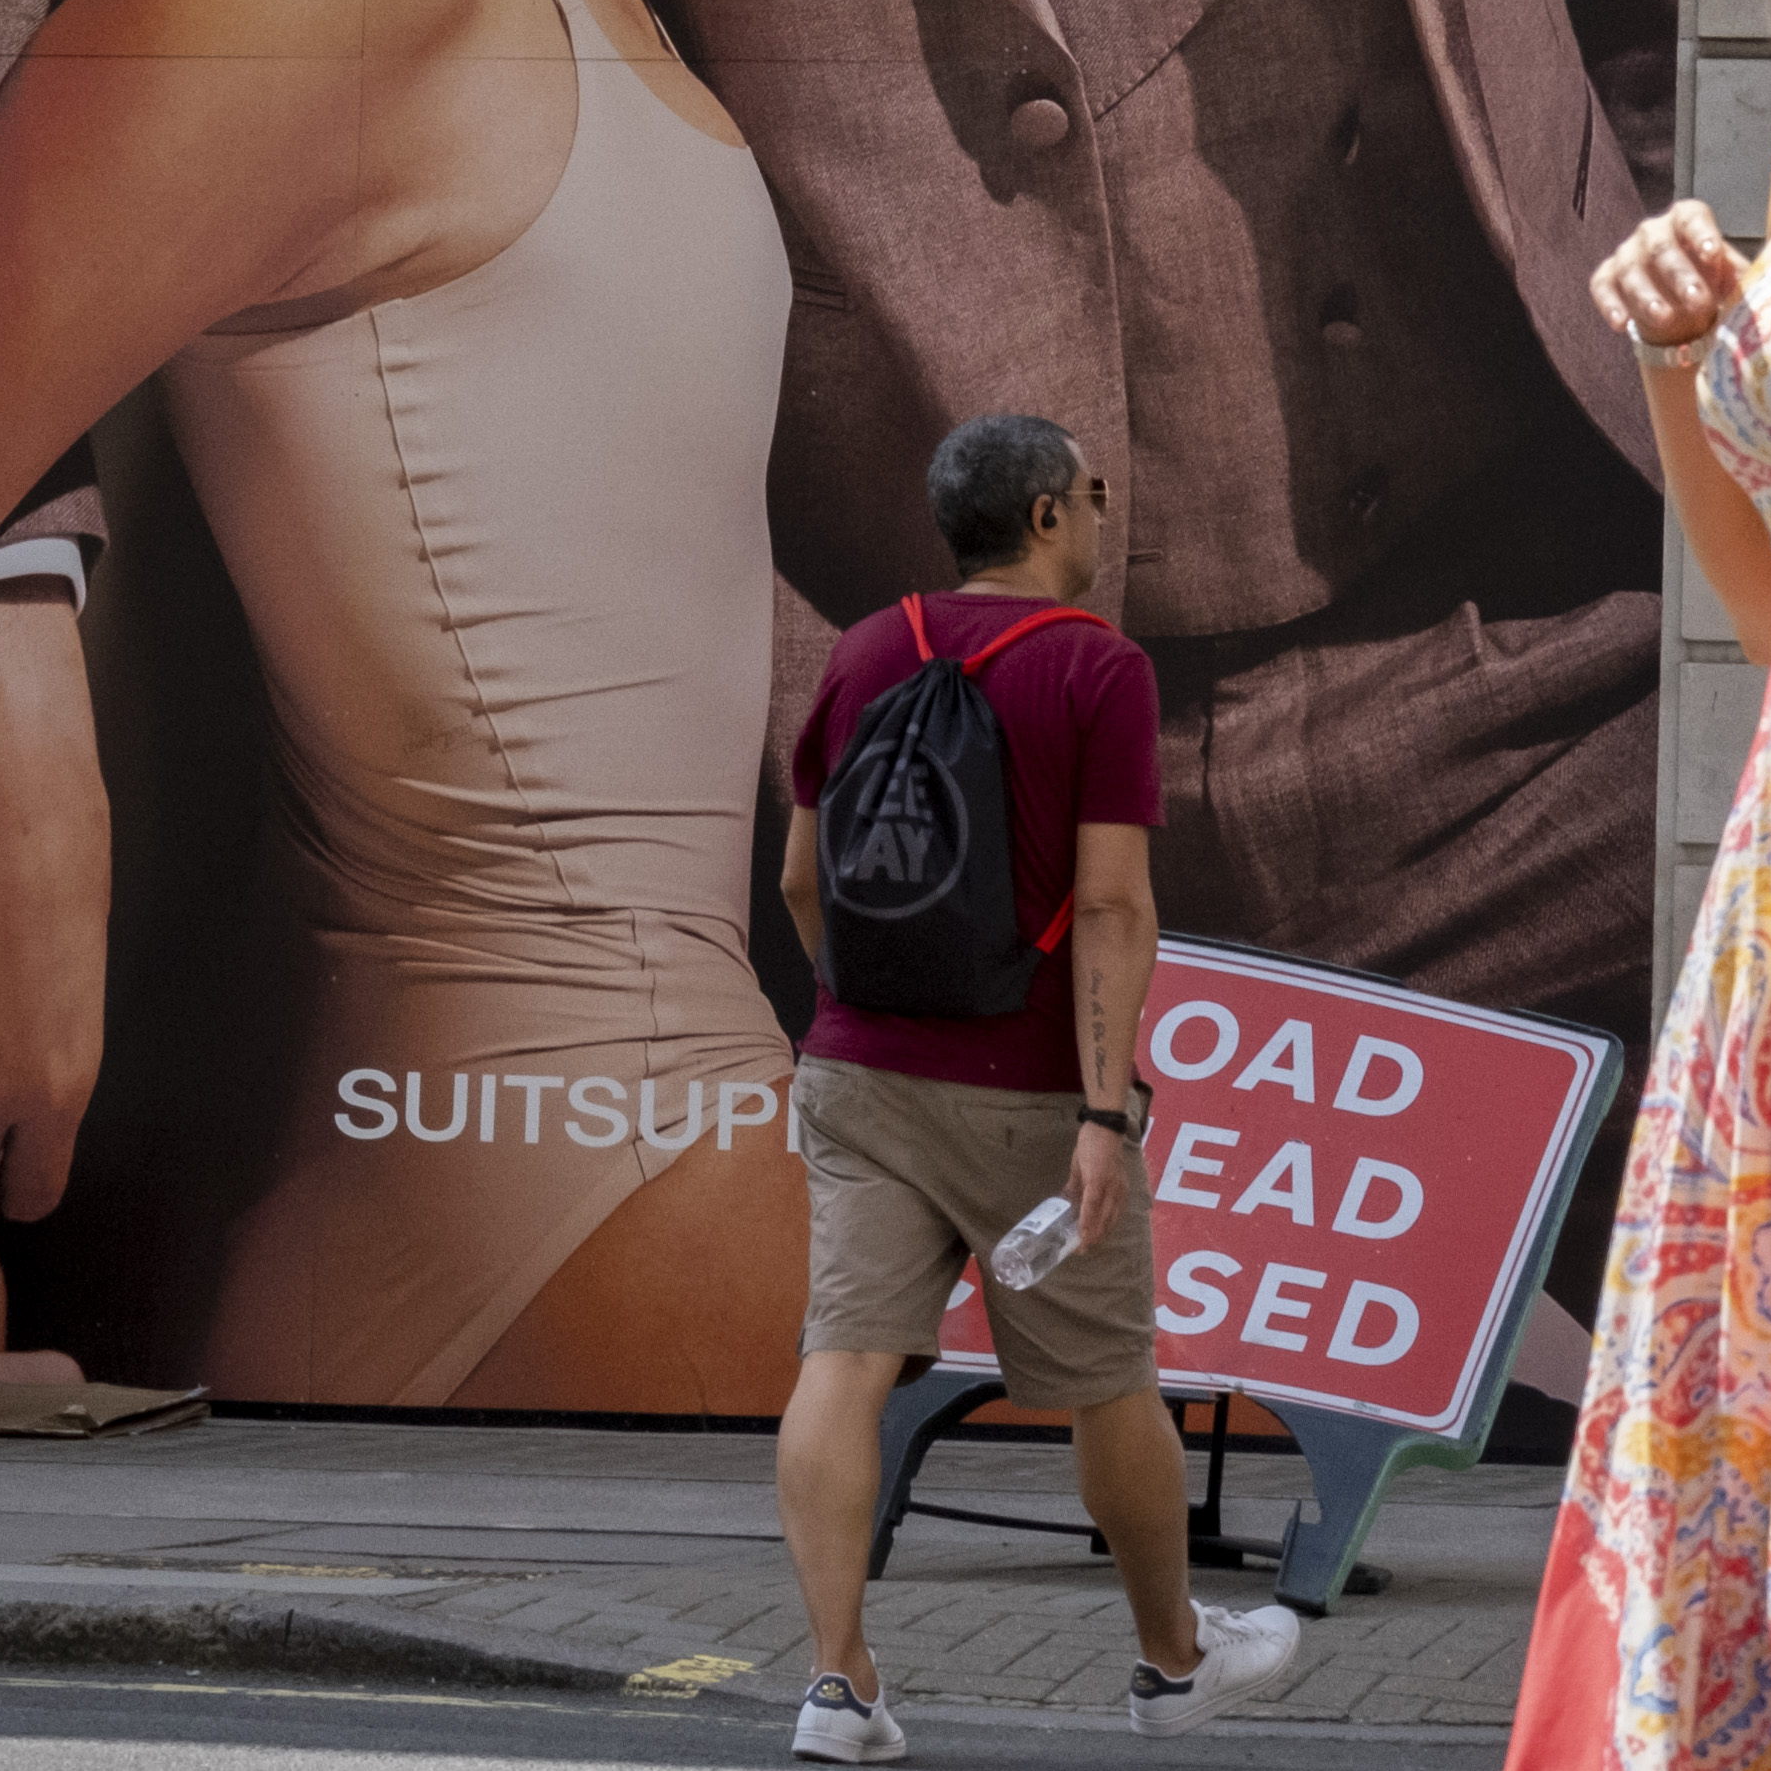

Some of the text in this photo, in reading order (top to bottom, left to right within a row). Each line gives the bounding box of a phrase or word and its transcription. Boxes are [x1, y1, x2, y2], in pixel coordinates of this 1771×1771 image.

[333, 1068, 798, 1153] SUITSUP
[1140, 1000, 1424, 1117] OAD
[1142, 1117, 1425, 1240] EAD
[1154, 1249, 1420, 1367] SED
